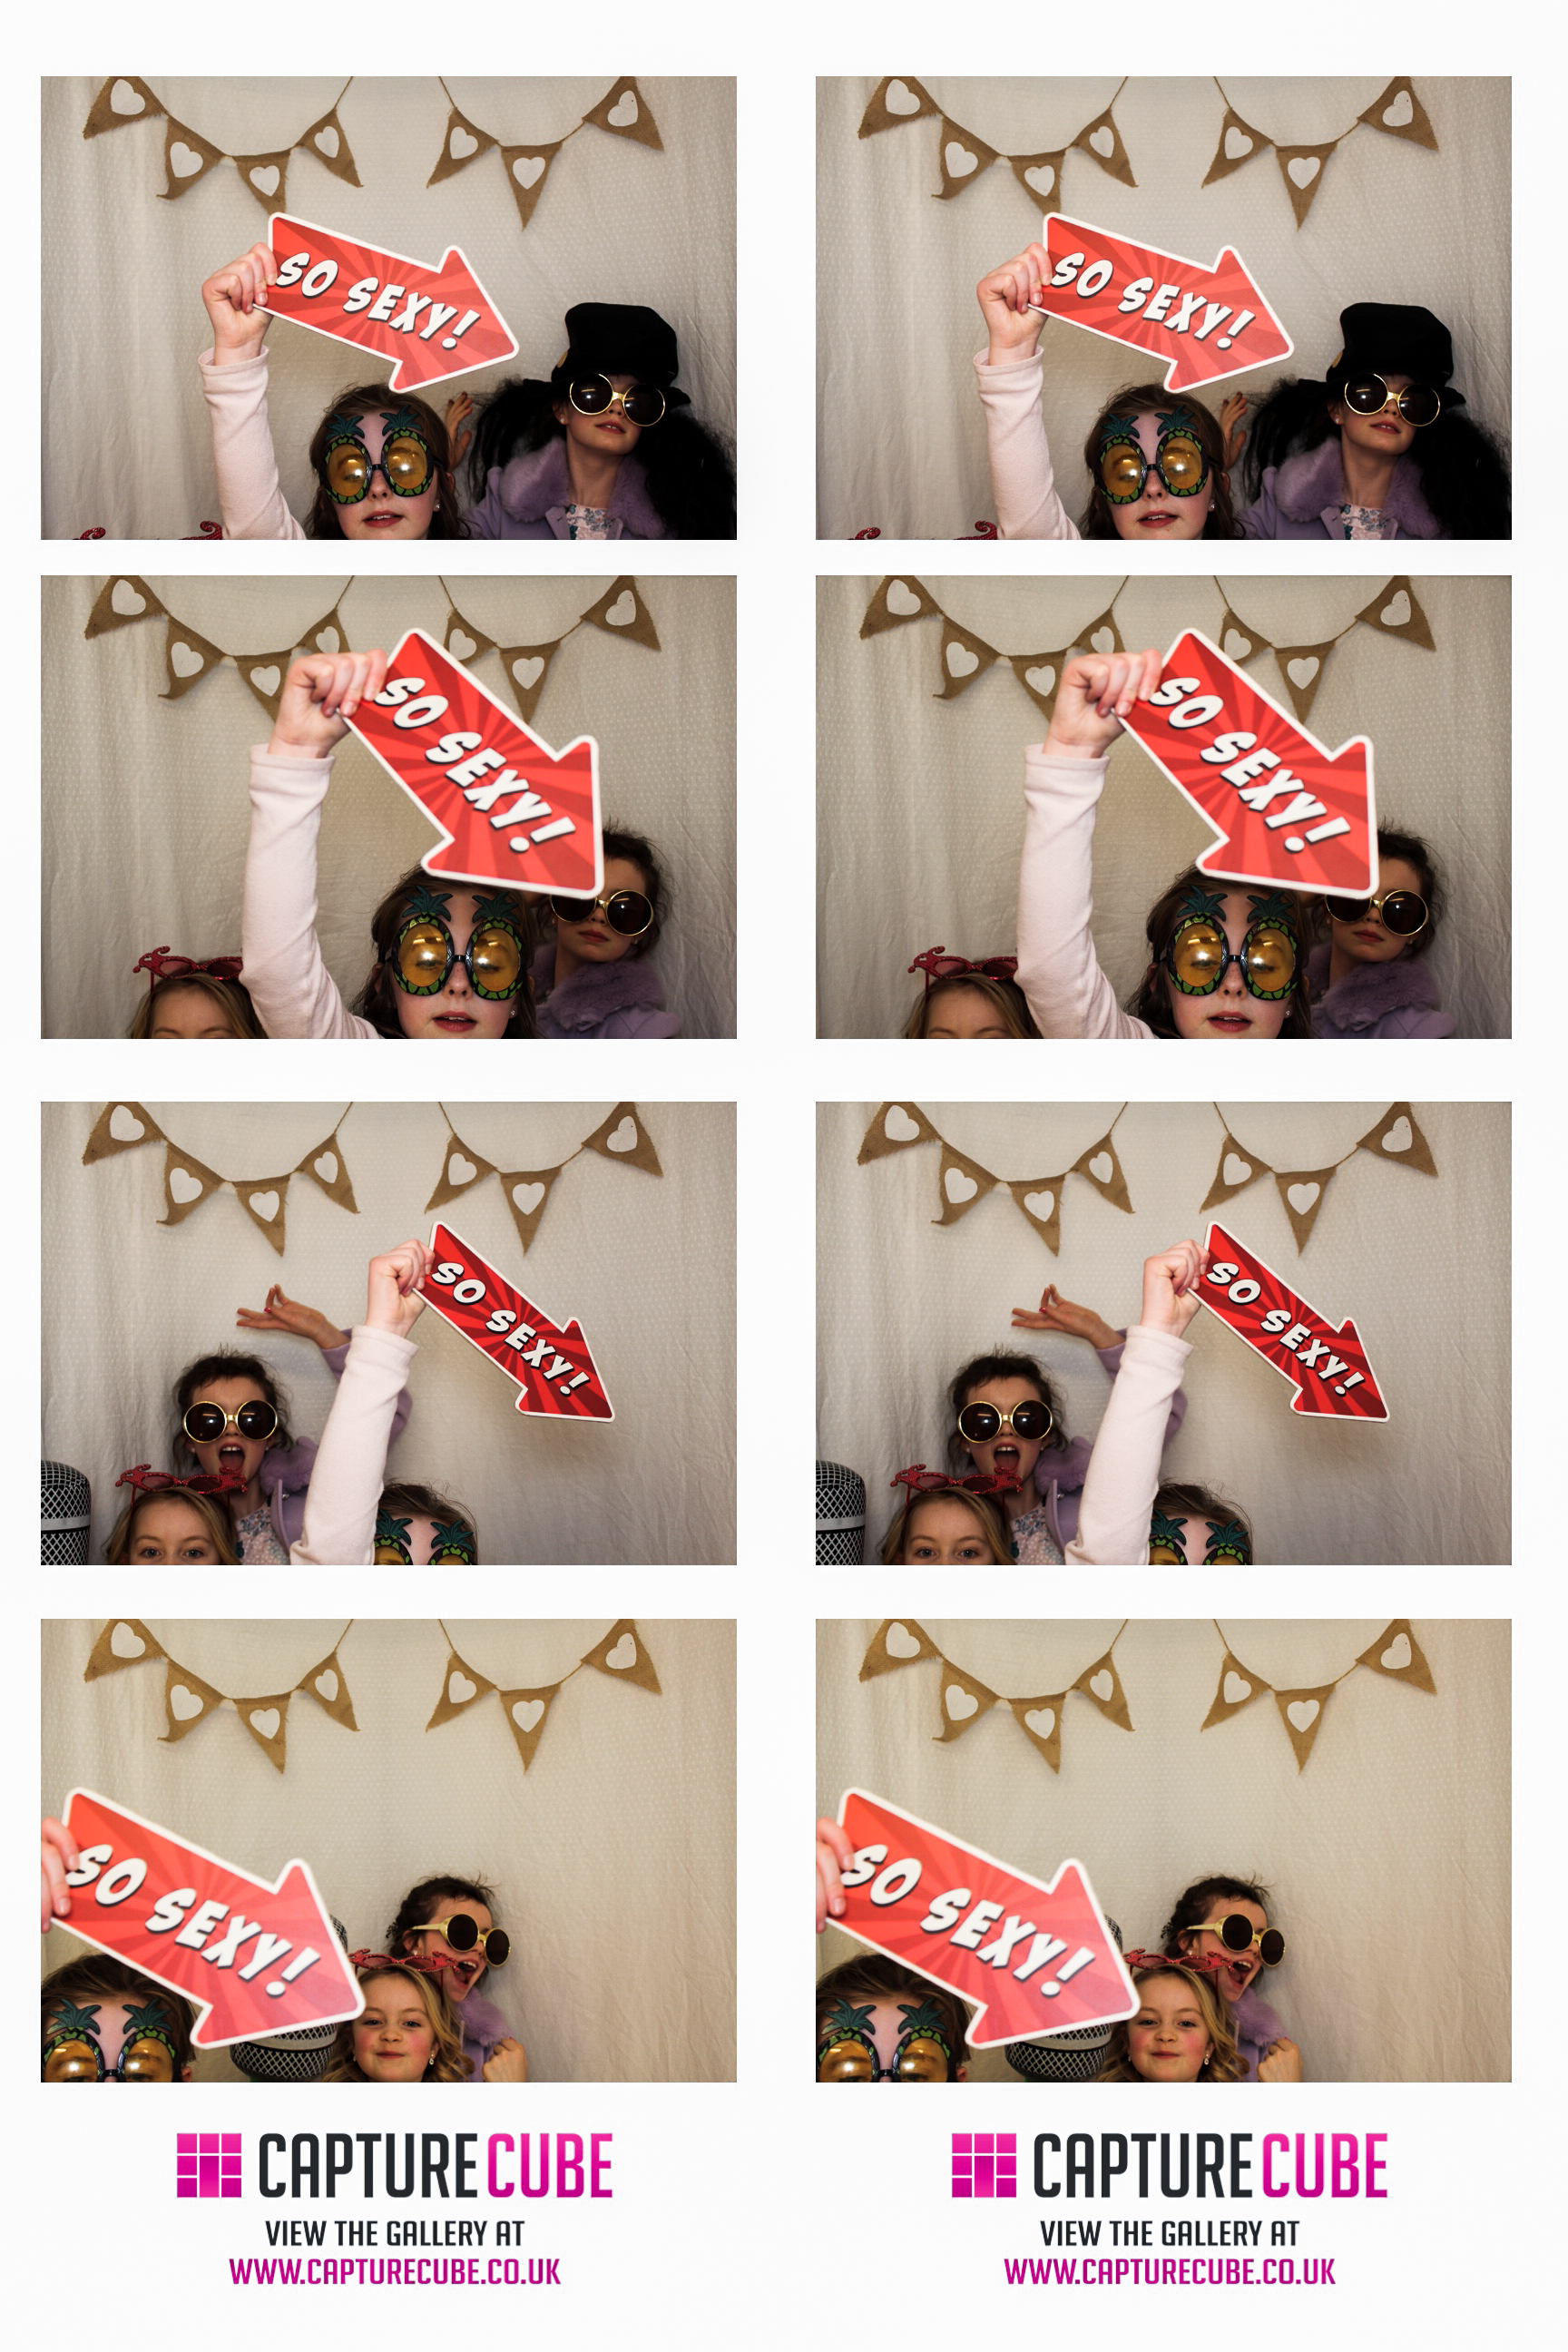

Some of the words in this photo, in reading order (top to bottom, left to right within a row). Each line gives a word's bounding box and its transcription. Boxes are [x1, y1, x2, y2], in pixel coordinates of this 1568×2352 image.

[276, 252, 338, 298] SO
[342, 277, 481, 351] SEXY!
[1051, 252, 1113, 298] SO
[1117, 277, 1256, 351] SEXY!
[374, 677, 449, 730] SO
[426, 731, 576, 853] SEXY!
[1149, 677, 1224, 730] SO
[1201, 731, 1351, 853] SEXY!
[431, 1262, 486, 1305] SO
[486, 1308, 590, 1397] SEXY!
[1206, 1262, 1261, 1305] SO
[1261, 1308, 1365, 1397] SEXY!
[65, 1844, 147, 1906] SO
[146, 1888, 320, 1998] SEXY!
[840, 1844, 922, 1906] SO
[921, 1888, 1095, 1998] SEXY!
